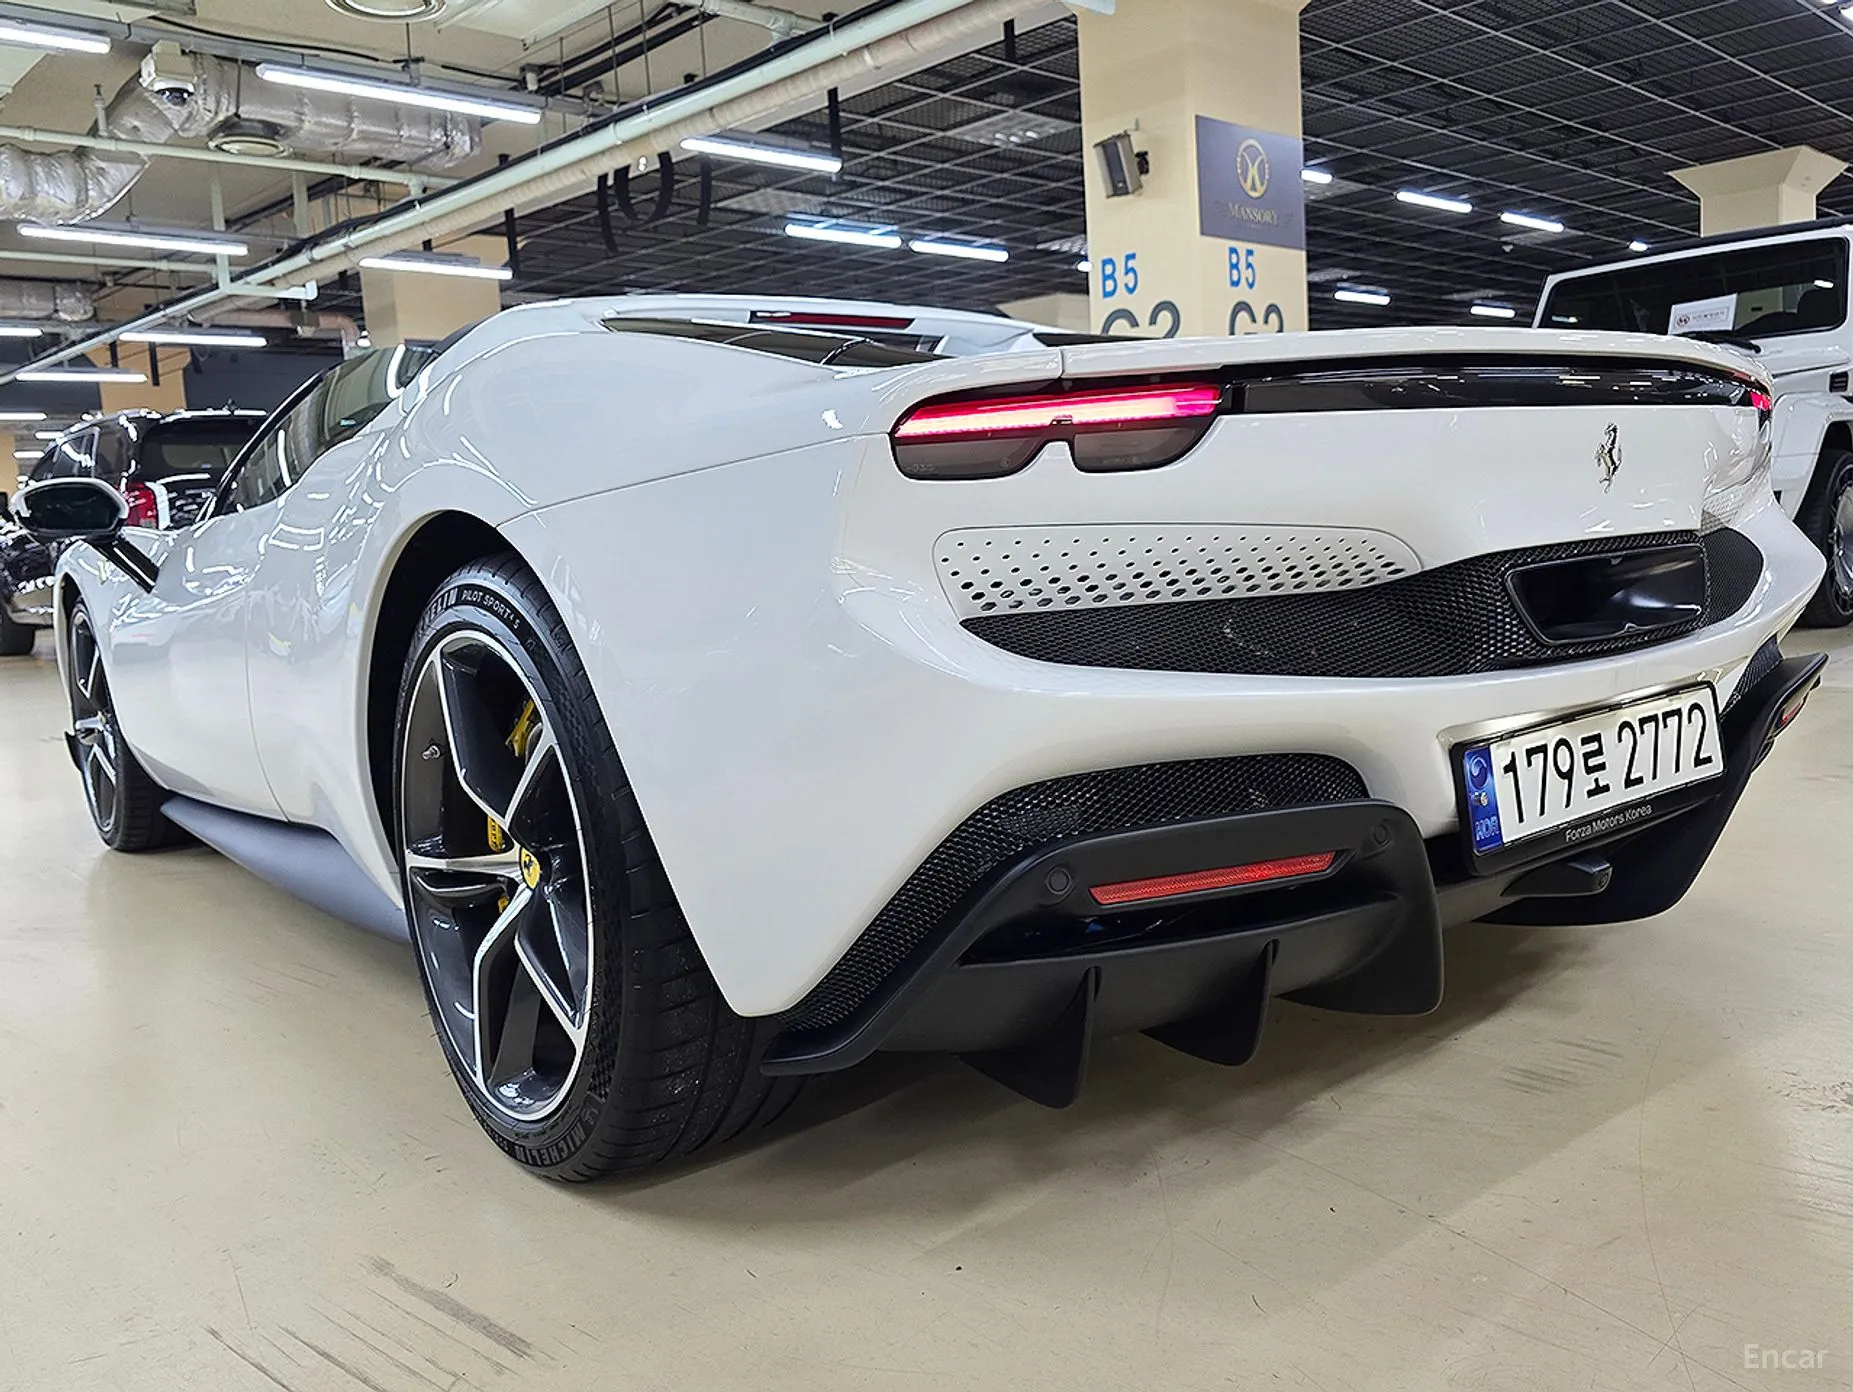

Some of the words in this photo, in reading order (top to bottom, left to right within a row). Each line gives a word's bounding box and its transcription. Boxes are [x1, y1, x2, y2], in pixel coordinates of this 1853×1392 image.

[1227, 202, 1278, 225] MANSORY
[1101, 252, 1139, 299] B5
[1228, 246, 1256, 290] B5
[461, 589, 484, 603] PILOT
[483, 594, 512, 621] SPORT
[1502, 732, 1611, 824] 179로
[1616, 701, 1714, 790] 2772
[1565, 825, 1592, 842] Forza
[1592, 813, 1625, 834] Motors
[1625, 804, 1653, 822] Korea
[515, 1121, 587, 1166] MICHELIN
